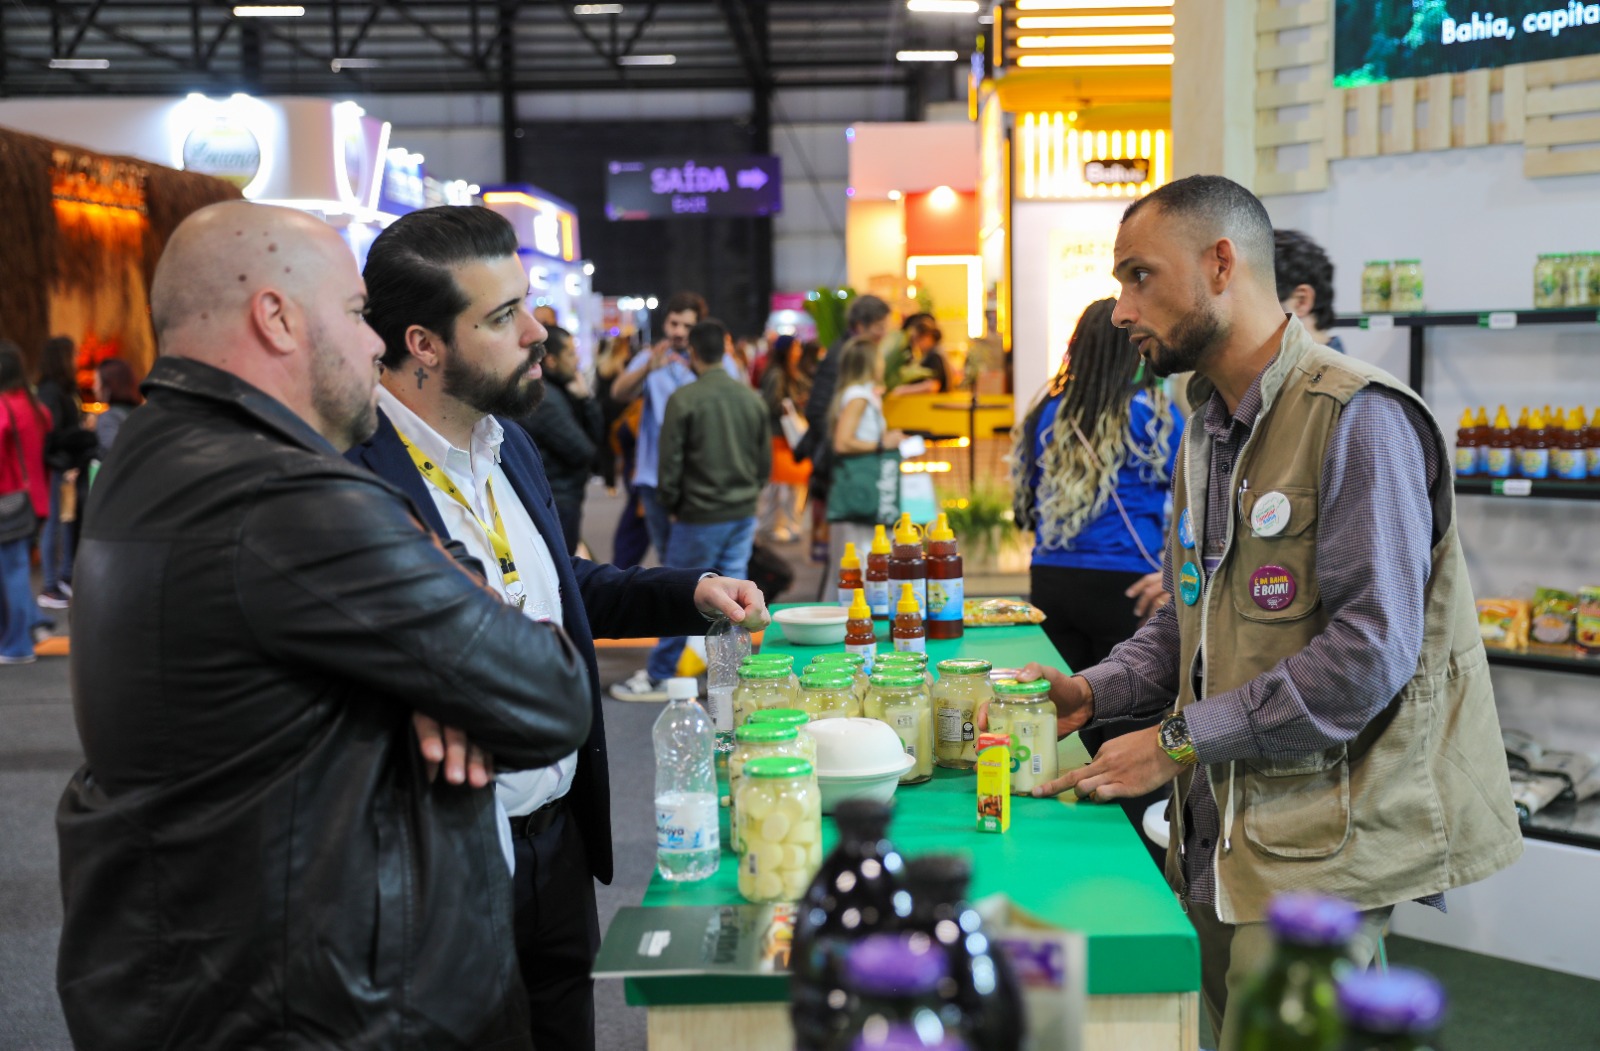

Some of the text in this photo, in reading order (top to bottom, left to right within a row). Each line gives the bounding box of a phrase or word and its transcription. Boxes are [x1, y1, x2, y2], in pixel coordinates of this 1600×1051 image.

[1441, 11, 1516, 45] Bahia,
[650, 160, 730, 194] SAÍDA
[1253, 583, 1289, 597] É BOM!
[1270, 575, 1288, 584] BAHIA
